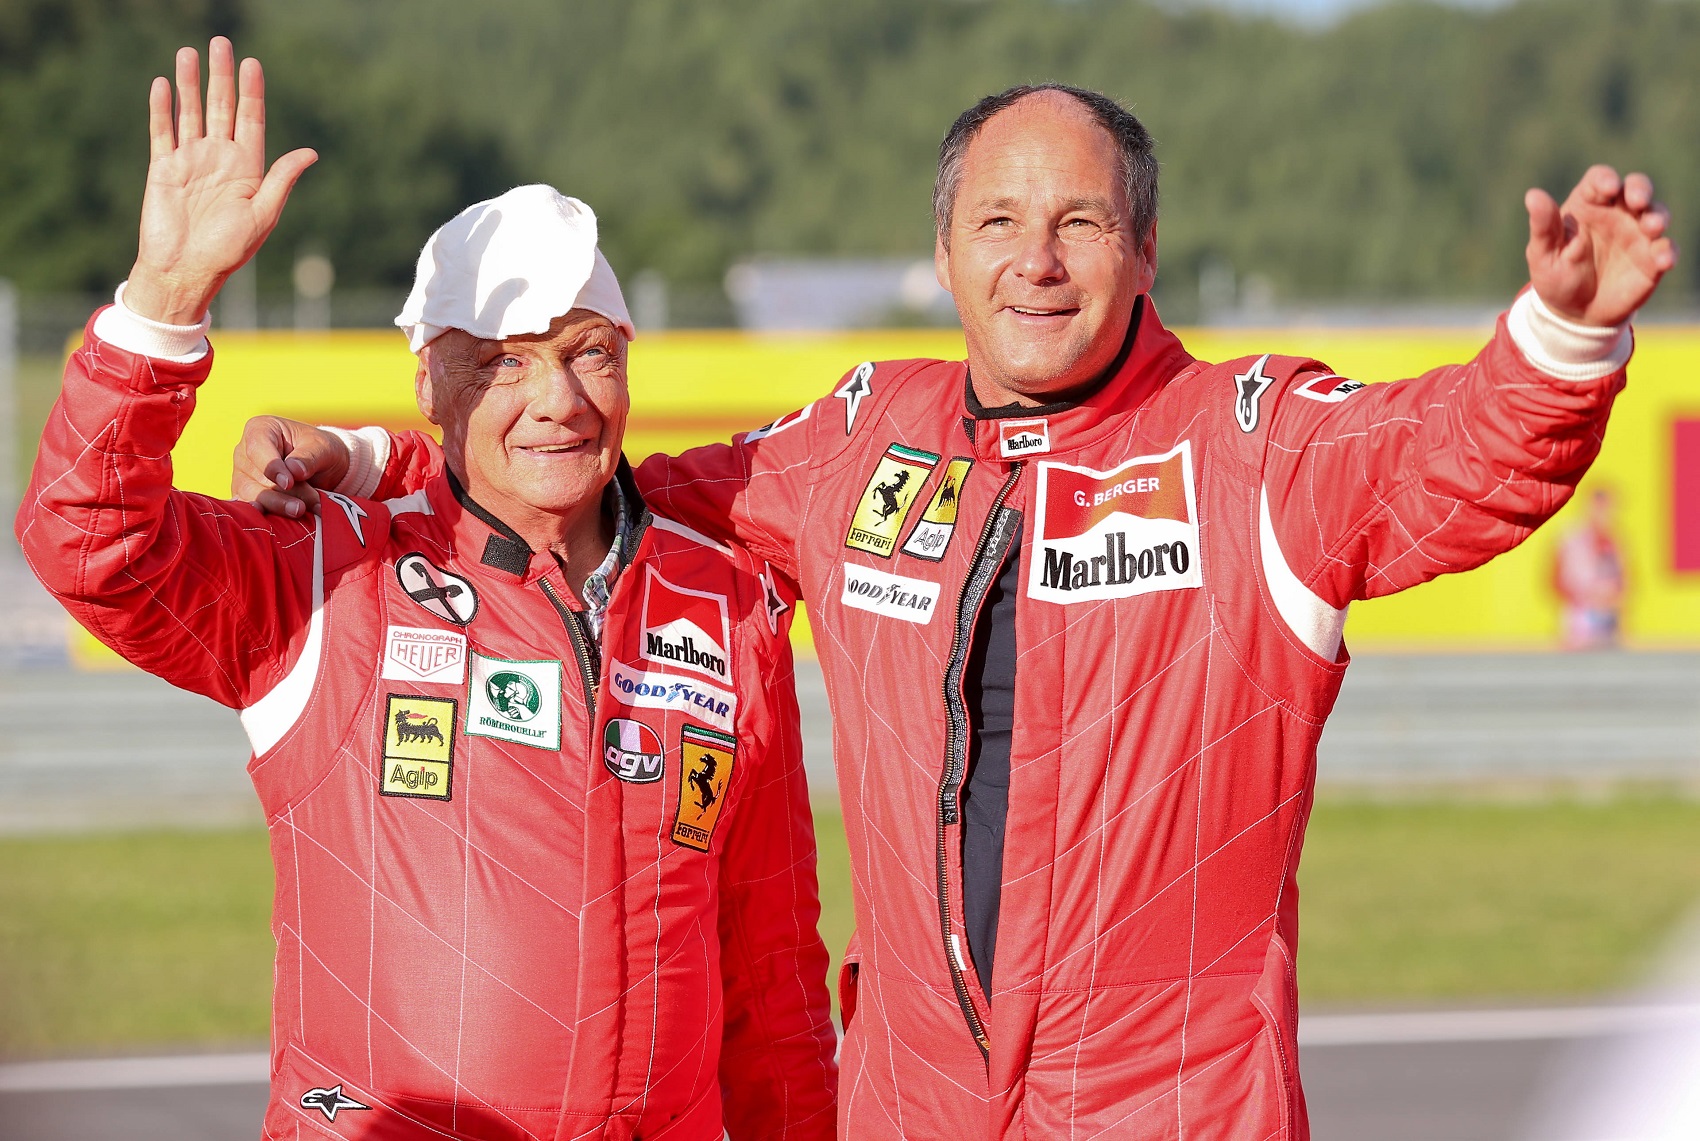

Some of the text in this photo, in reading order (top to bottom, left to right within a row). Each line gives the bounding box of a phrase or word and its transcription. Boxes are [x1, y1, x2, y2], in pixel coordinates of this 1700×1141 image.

[1007, 435, 1043, 451] Marlboro
[1073, 477, 1160, 508] G. BERGER
[849, 527, 893, 550] Ferrari
[912, 527, 945, 551] Agip
[1040, 531, 1190, 591] Marlboro
[393, 630, 463, 645] CHRONOGRAPH
[397, 643, 457, 672] HEUER
[646, 631, 726, 677] Marlboro
[389, 763, 439, 790] Agip
[606, 748, 661, 778] agv
[675, 821, 710, 844] Ferrari
